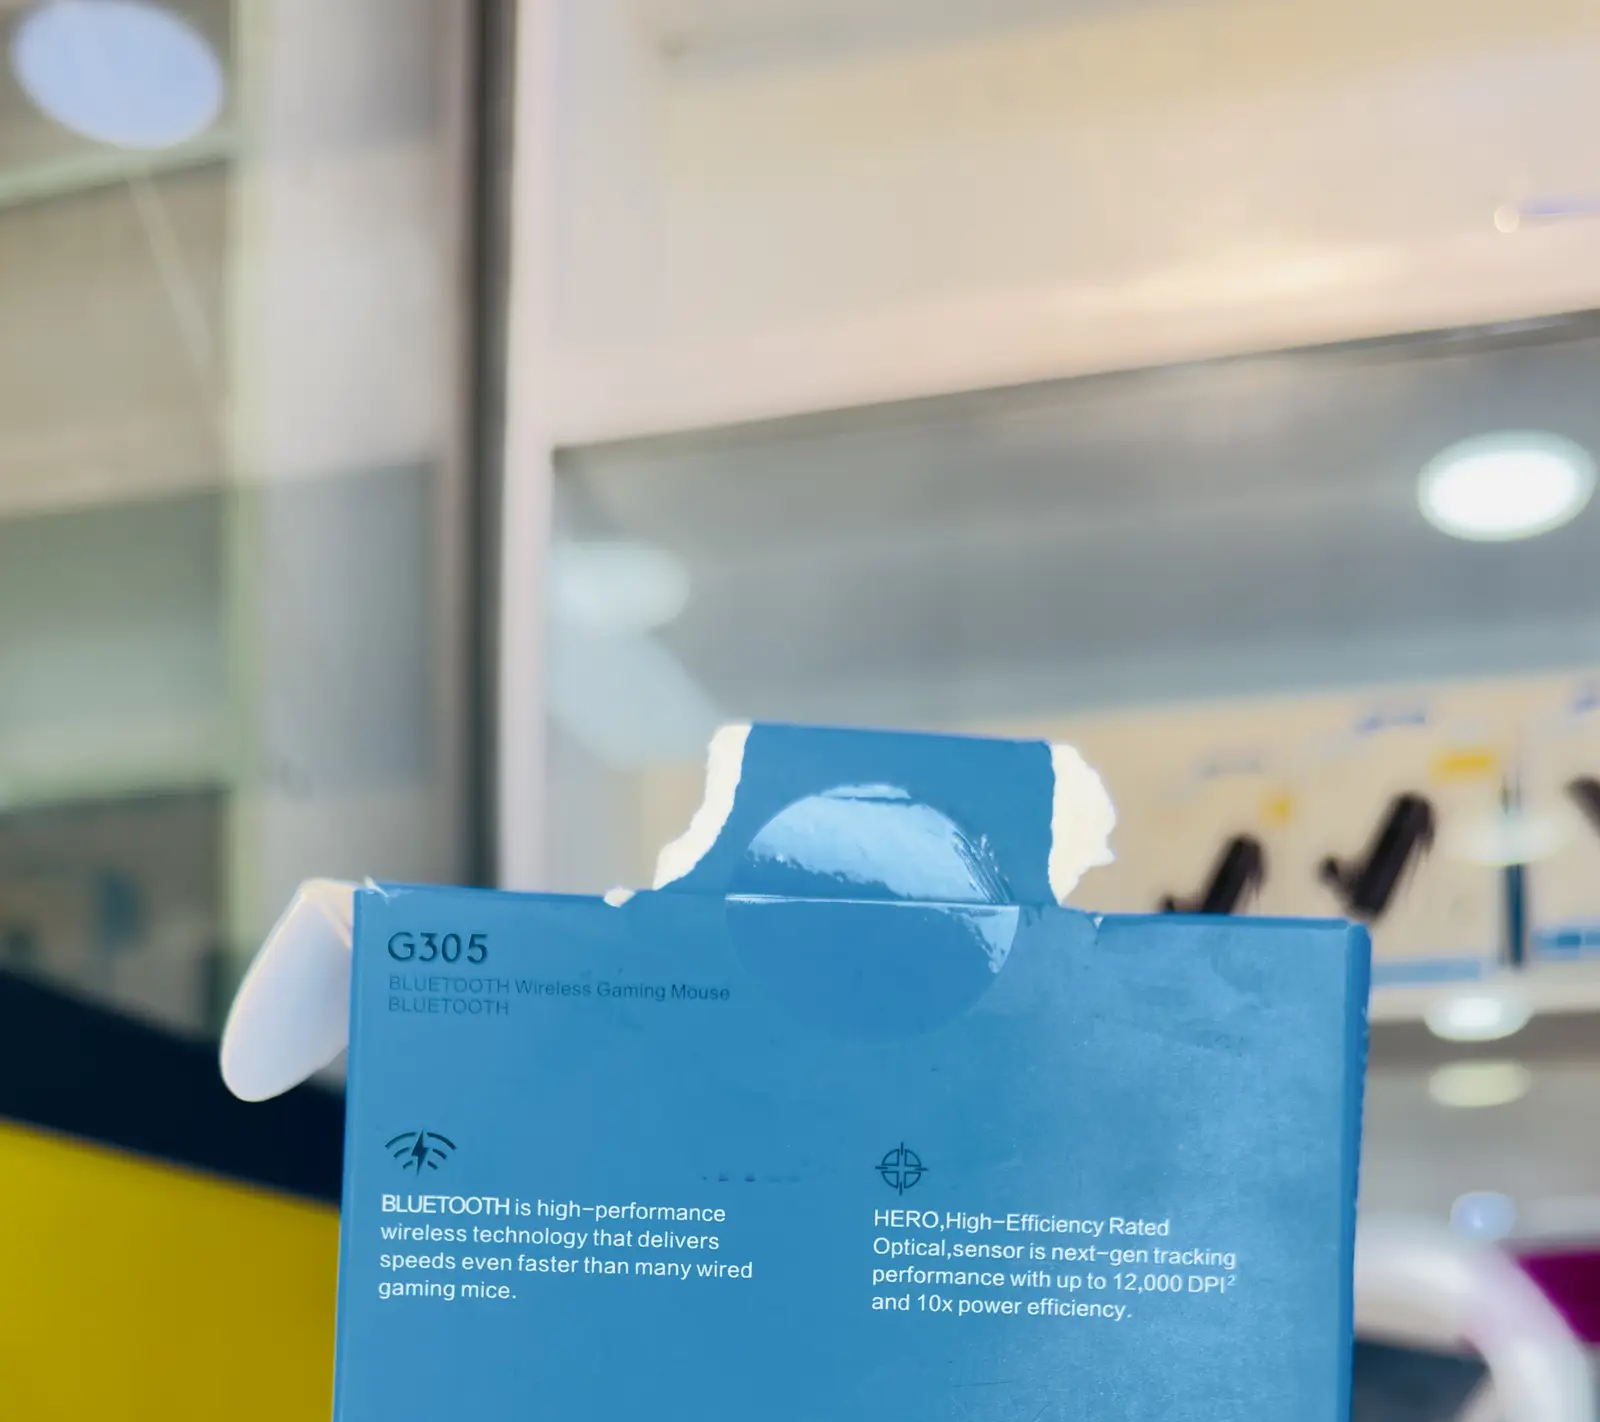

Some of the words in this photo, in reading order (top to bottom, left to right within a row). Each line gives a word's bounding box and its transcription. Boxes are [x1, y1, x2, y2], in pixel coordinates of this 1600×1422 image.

[387, 931, 488, 965] G305
[389, 975, 510, 995] BLUETOOTH
[514, 979, 592, 997] Wireless
[596, 981, 666, 1003] Gaming
[670, 983, 730, 1001] Mouse
[388, 996, 509, 1016] BLUETOOTH
[381, 1193, 510, 1216] BLUETOOTH
[515, 1198, 532, 1217] is
[537, 1199, 726, 1223] high-performance
[380, 1223, 467, 1242] wireless
[472, 1226, 589, 1249] technology
[592, 1229, 633, 1247] that
[637, 1230, 720, 1250] delivers
[1109, 1217, 1170, 1236] Rated
[380, 1252, 456, 1272] speeds
[461, 1256, 512, 1271] even
[517, 1254, 580, 1273] faster
[583, 1256, 629, 1275] than
[635, 1261, 692, 1281] many
[696, 1260, 753, 1279] wired
[1029, 1242, 1047, 1260] is
[1051, 1245, 1148, 1267] next-gen
[1153, 1247, 1236, 1270] tracking
[378, 1279, 456, 1302] gaming
[461, 1281, 516, 1299] mice.
[872, 1265, 1005, 1287] performance
[1009, 1270, 1051, 1288] with
[1056, 1275, 1082, 1293] up
[1086, 1272, 1107, 1290] to
[1113, 1272, 1183, 1294] 12,000
[871, 1293, 910, 1311] and
[917, 1293, 953, 1313] 10x
[958, 1299, 1022, 1317] power
[1027, 1297, 1132, 1322] efficiency.
